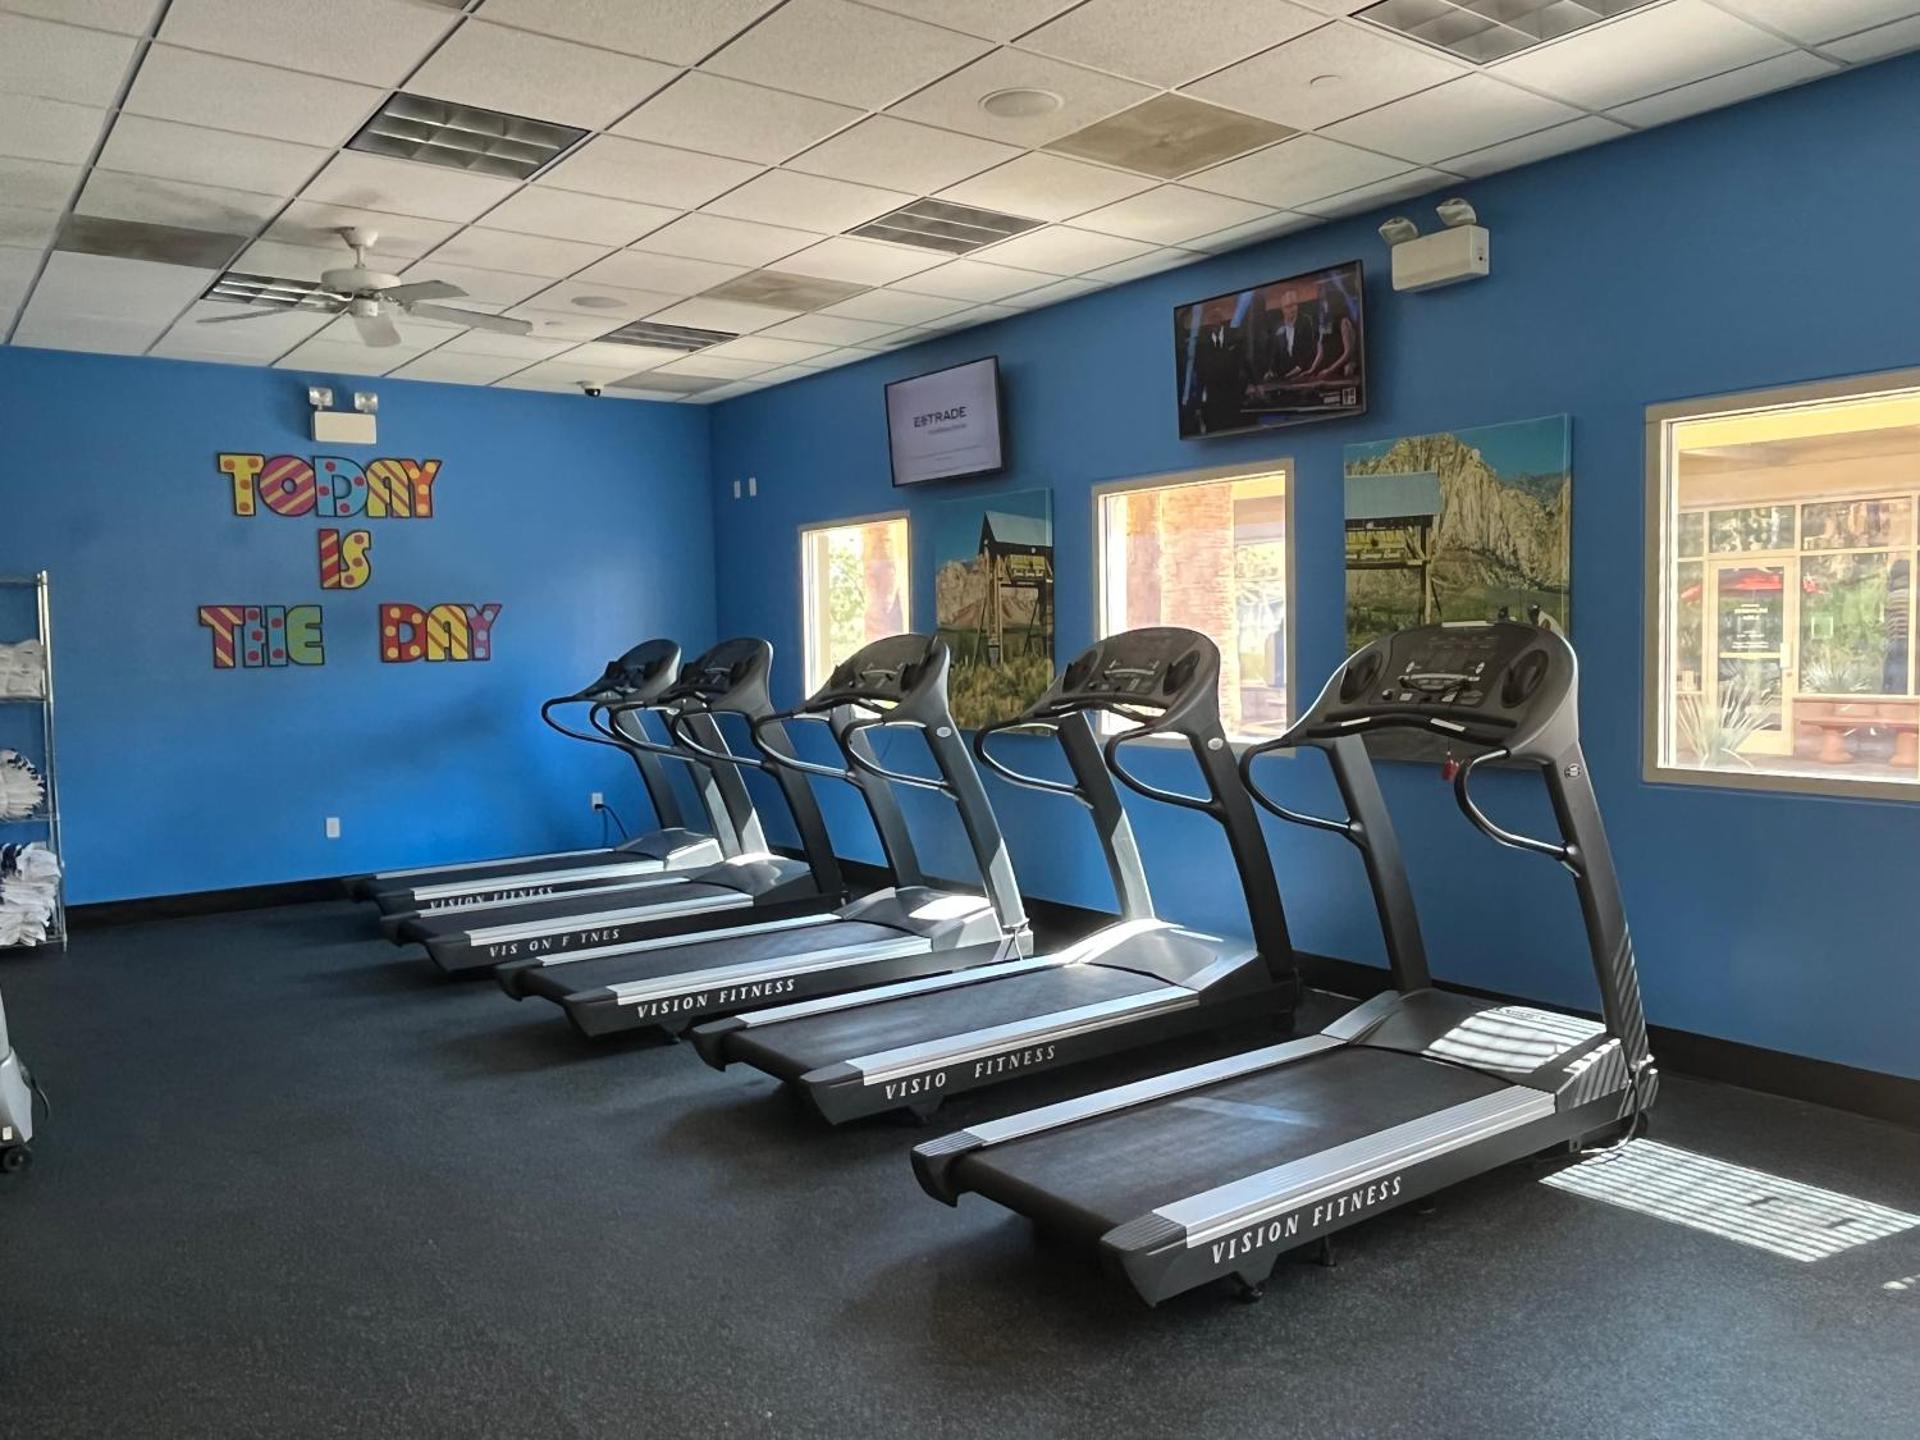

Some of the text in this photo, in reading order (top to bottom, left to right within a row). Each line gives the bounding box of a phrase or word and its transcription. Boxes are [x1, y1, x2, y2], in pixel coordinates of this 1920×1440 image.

[217, 453, 442, 518] TODAY
[318, 528, 371, 590] IS
[199, 603, 502, 669] THE DAY
[637, 979, 795, 1019] VISION FITNESS
[974, 1045, 1056, 1078] FITNESS
[1211, 1176, 1401, 1264] VISION FITNESS
